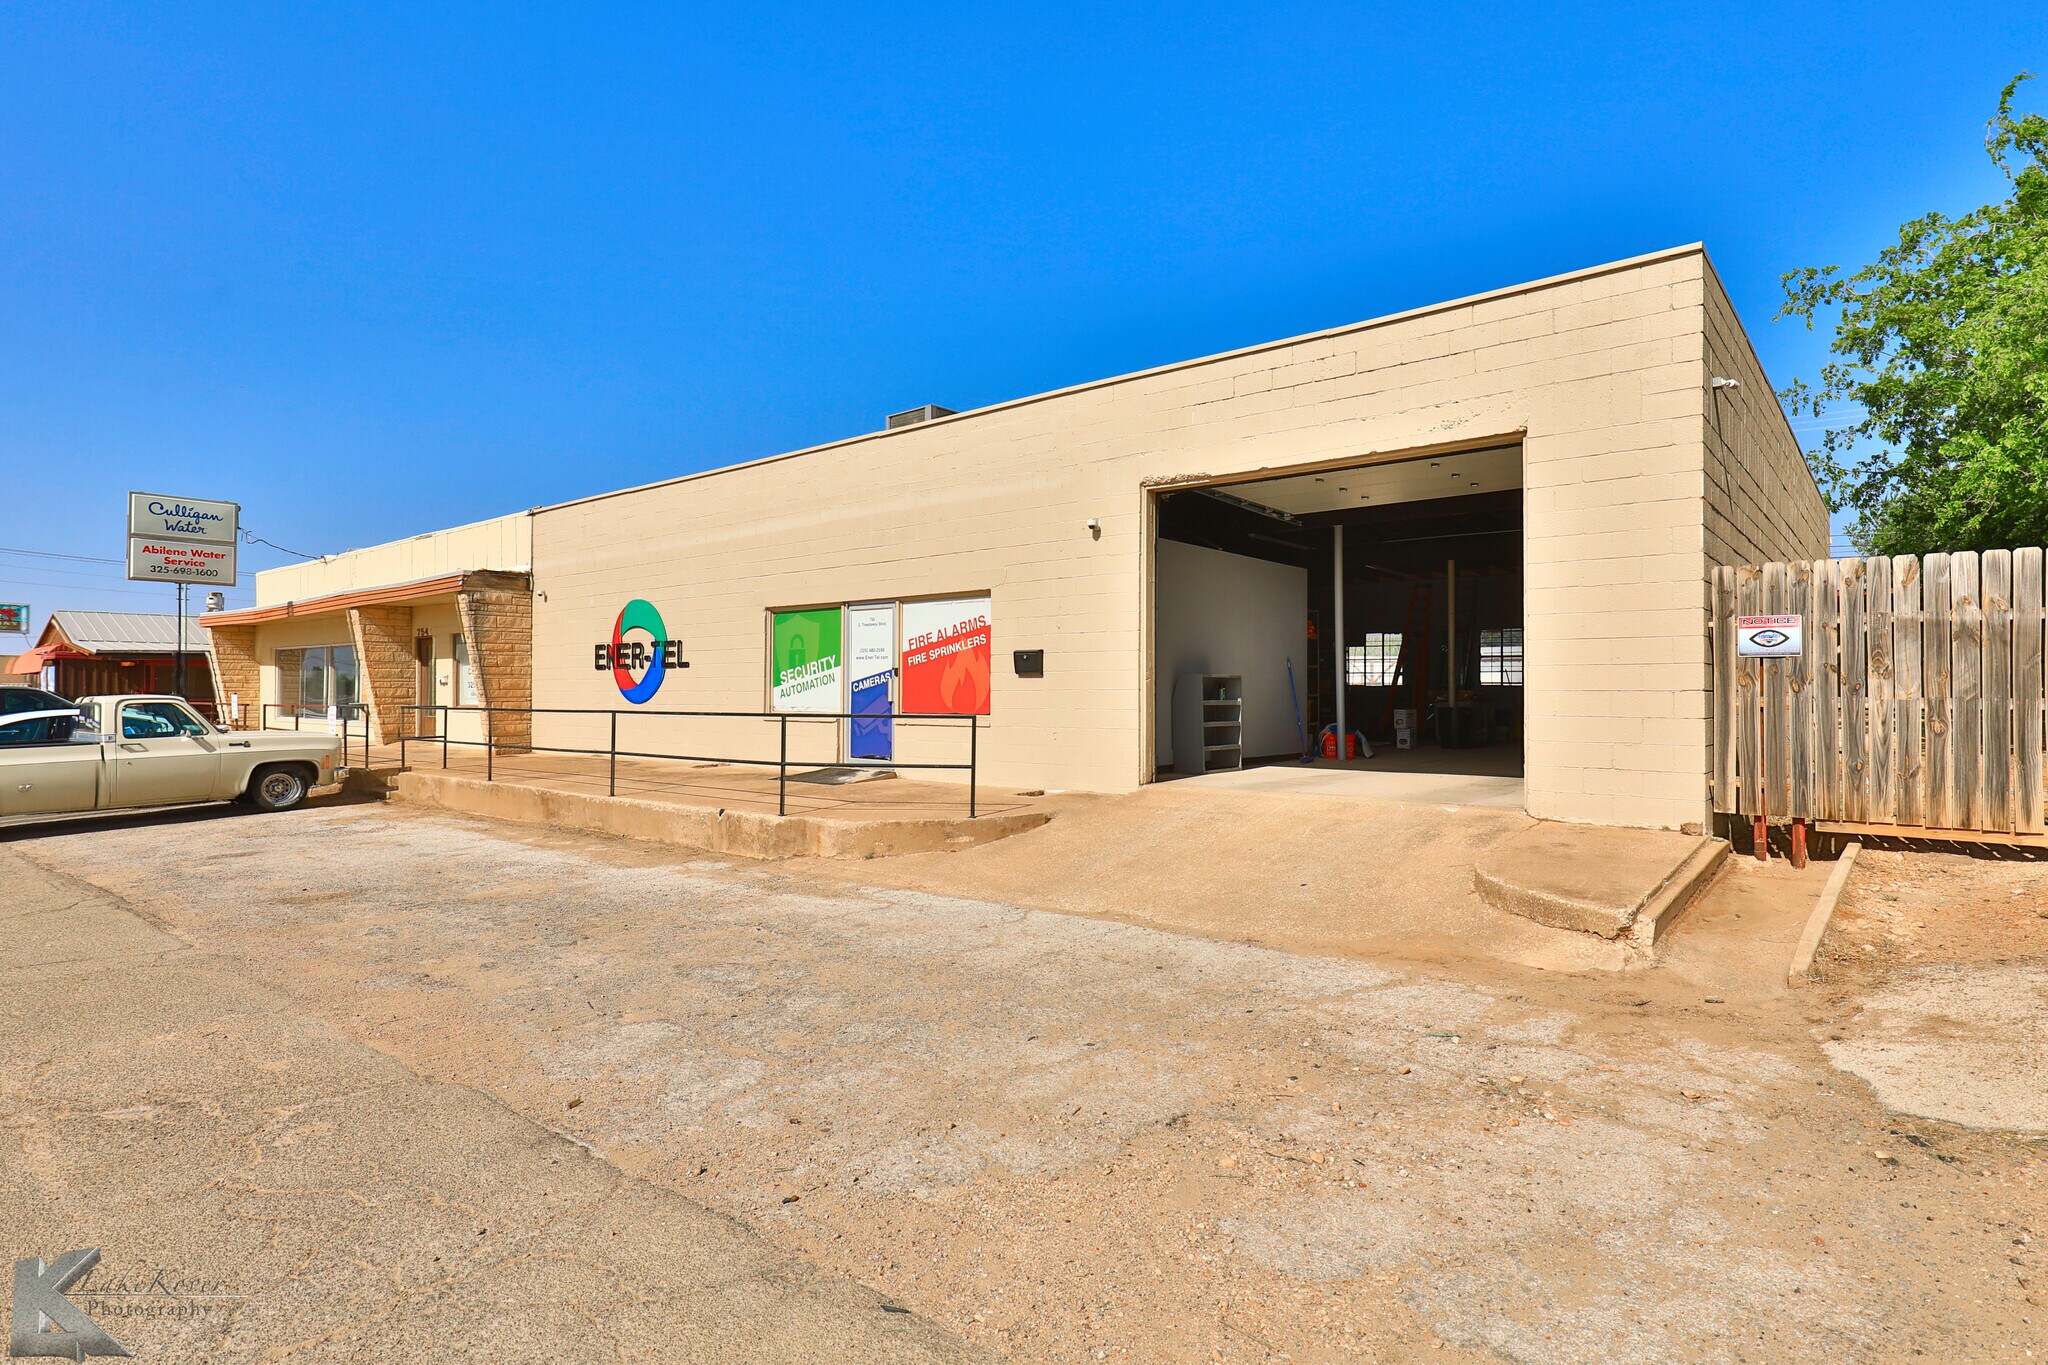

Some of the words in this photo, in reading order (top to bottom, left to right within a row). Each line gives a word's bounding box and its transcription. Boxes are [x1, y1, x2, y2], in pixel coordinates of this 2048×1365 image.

[148, 502, 223, 525] Culligan
[164, 519, 207, 535] Water
[142, 545, 187, 557] Abilene
[190, 549, 226, 560] Water
[163, 557, 206, 568] Service
[149, 565, 218, 577] 325-698-1600
[417, 627, 429, 636] 754
[1742, 617, 1796, 625] NOTICE
[908, 632, 934, 651] FIRE
[936, 615, 987, 642] ALARMS
[594, 639, 690, 671] ENER-TEL
[907, 652, 928, 667] FIRE
[928, 633, 987, 661] SPRINKLERS
[779, 654, 836, 685] SECURITY
[779, 672, 836, 699] AUTOMATION
[852, 672, 892, 693] CAMERAS
